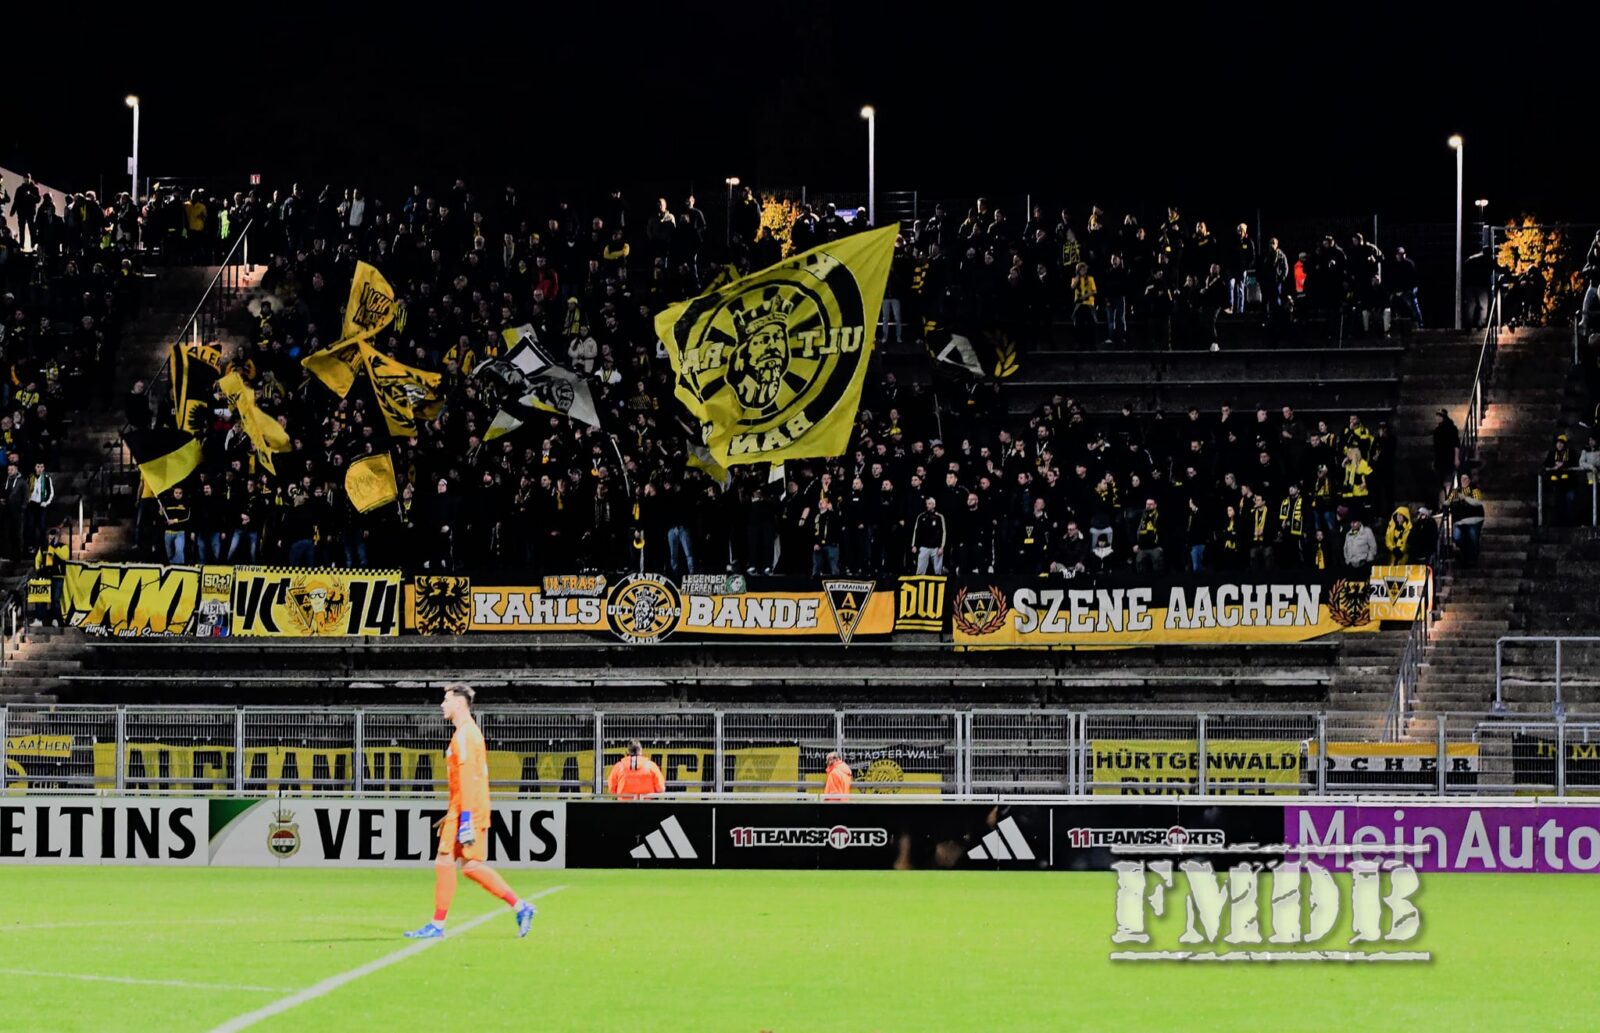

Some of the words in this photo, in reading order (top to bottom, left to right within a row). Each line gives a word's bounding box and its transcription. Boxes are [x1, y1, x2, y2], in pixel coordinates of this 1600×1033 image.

[204, 574, 231, 588] 50+1
[543, 575, 596, 591] ULTRAS
[627, 572, 667, 586] KARLS
[682, 574, 727, 584] LEGENDEN
[346, 580, 398, 636] 14
[473, 593, 601, 625] KARLS
[841, 592, 857, 609] A
[1013, 587, 1152, 634] SZENE
[1163, 584, 1322, 630] AACHEN
[686, 595, 821, 629] BANDE
[1371, 603, 1418, 618] JONG
[18, 739, 71, 752] AACHEN
[1096, 748, 1298, 770] HÜRTGENWALD
[0, 806, 197, 860] ELTINS
[313, 807, 558, 862] VELTNS
